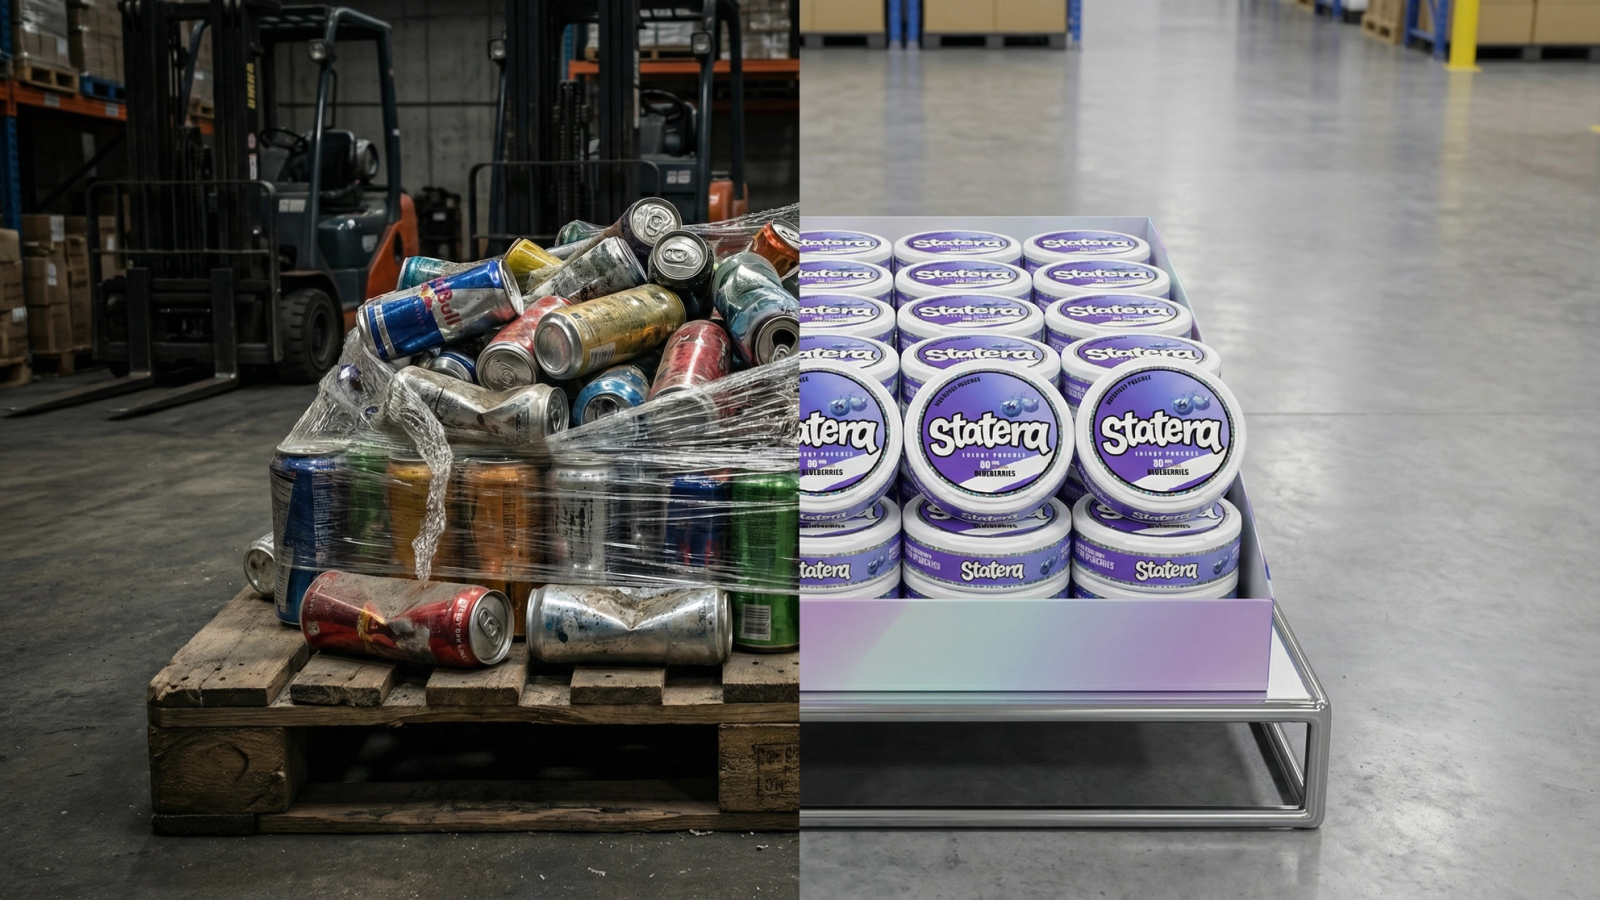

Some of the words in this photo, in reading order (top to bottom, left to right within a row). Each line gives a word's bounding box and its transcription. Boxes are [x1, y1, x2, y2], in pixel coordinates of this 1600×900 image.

[913, 238, 1003, 248] Statera
[1041, 238, 1131, 248] Statera
[799, 269, 874, 279] tatera
[915, 269, 1012, 280] Statera
[1053, 269, 1150, 280] Statera
[437, 289, 462, 326] Bull
[799, 305, 874, 316] atera
[918, 305, 1023, 317] Statera
[1066, 304, 1171, 317] Statera
[799, 347, 877, 361] atera
[924, 347, 1039, 362] Statera
[1084, 346, 1200, 361] Statera
[799, 410, 880, 455] atera
[928, 410, 1052, 457] Statera
[1100, 409, 1225, 457] Statera
[807, 459, 818, 468] 80
[979, 460, 991, 469] 80
[1153, 459, 1164, 468] 80
[799, 512, 847, 521] tatera
[799, 560, 852, 580] tatera
[960, 560, 1025, 582] Statera
[1134, 560, 1199, 582] Statera
